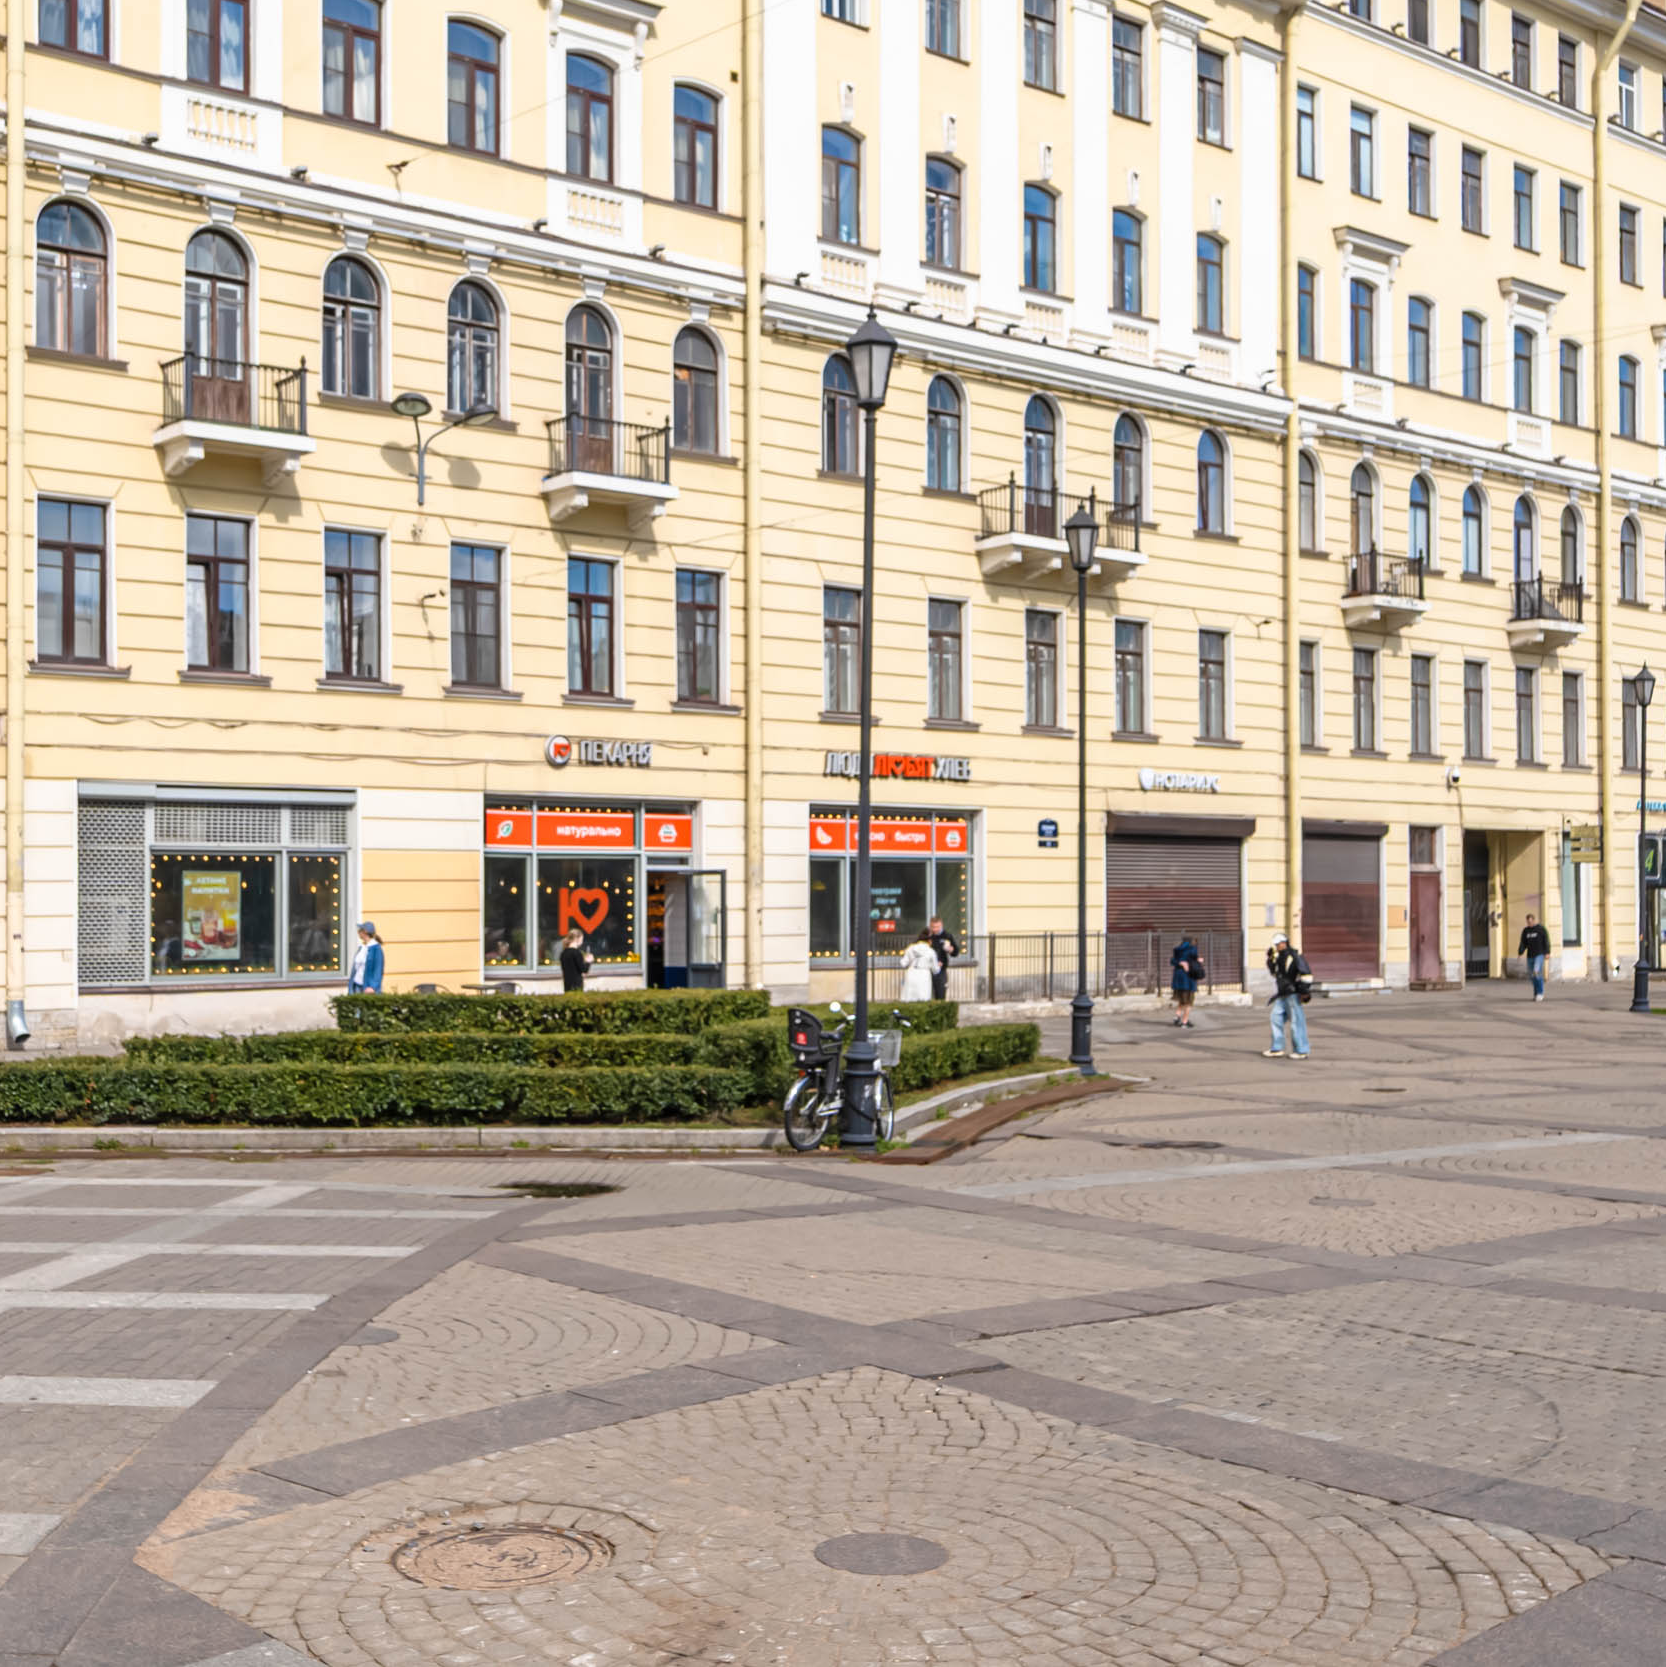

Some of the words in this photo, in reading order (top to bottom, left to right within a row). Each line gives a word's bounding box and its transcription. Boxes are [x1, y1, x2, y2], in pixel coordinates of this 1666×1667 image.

[580, 741, 653, 766] ПЕКАРНЯ
[936, 757, 972, 780] ХЛЕБ
[1155, 772, 1220, 792] НОТАРИУС
[557, 824, 622, 839] натурально
